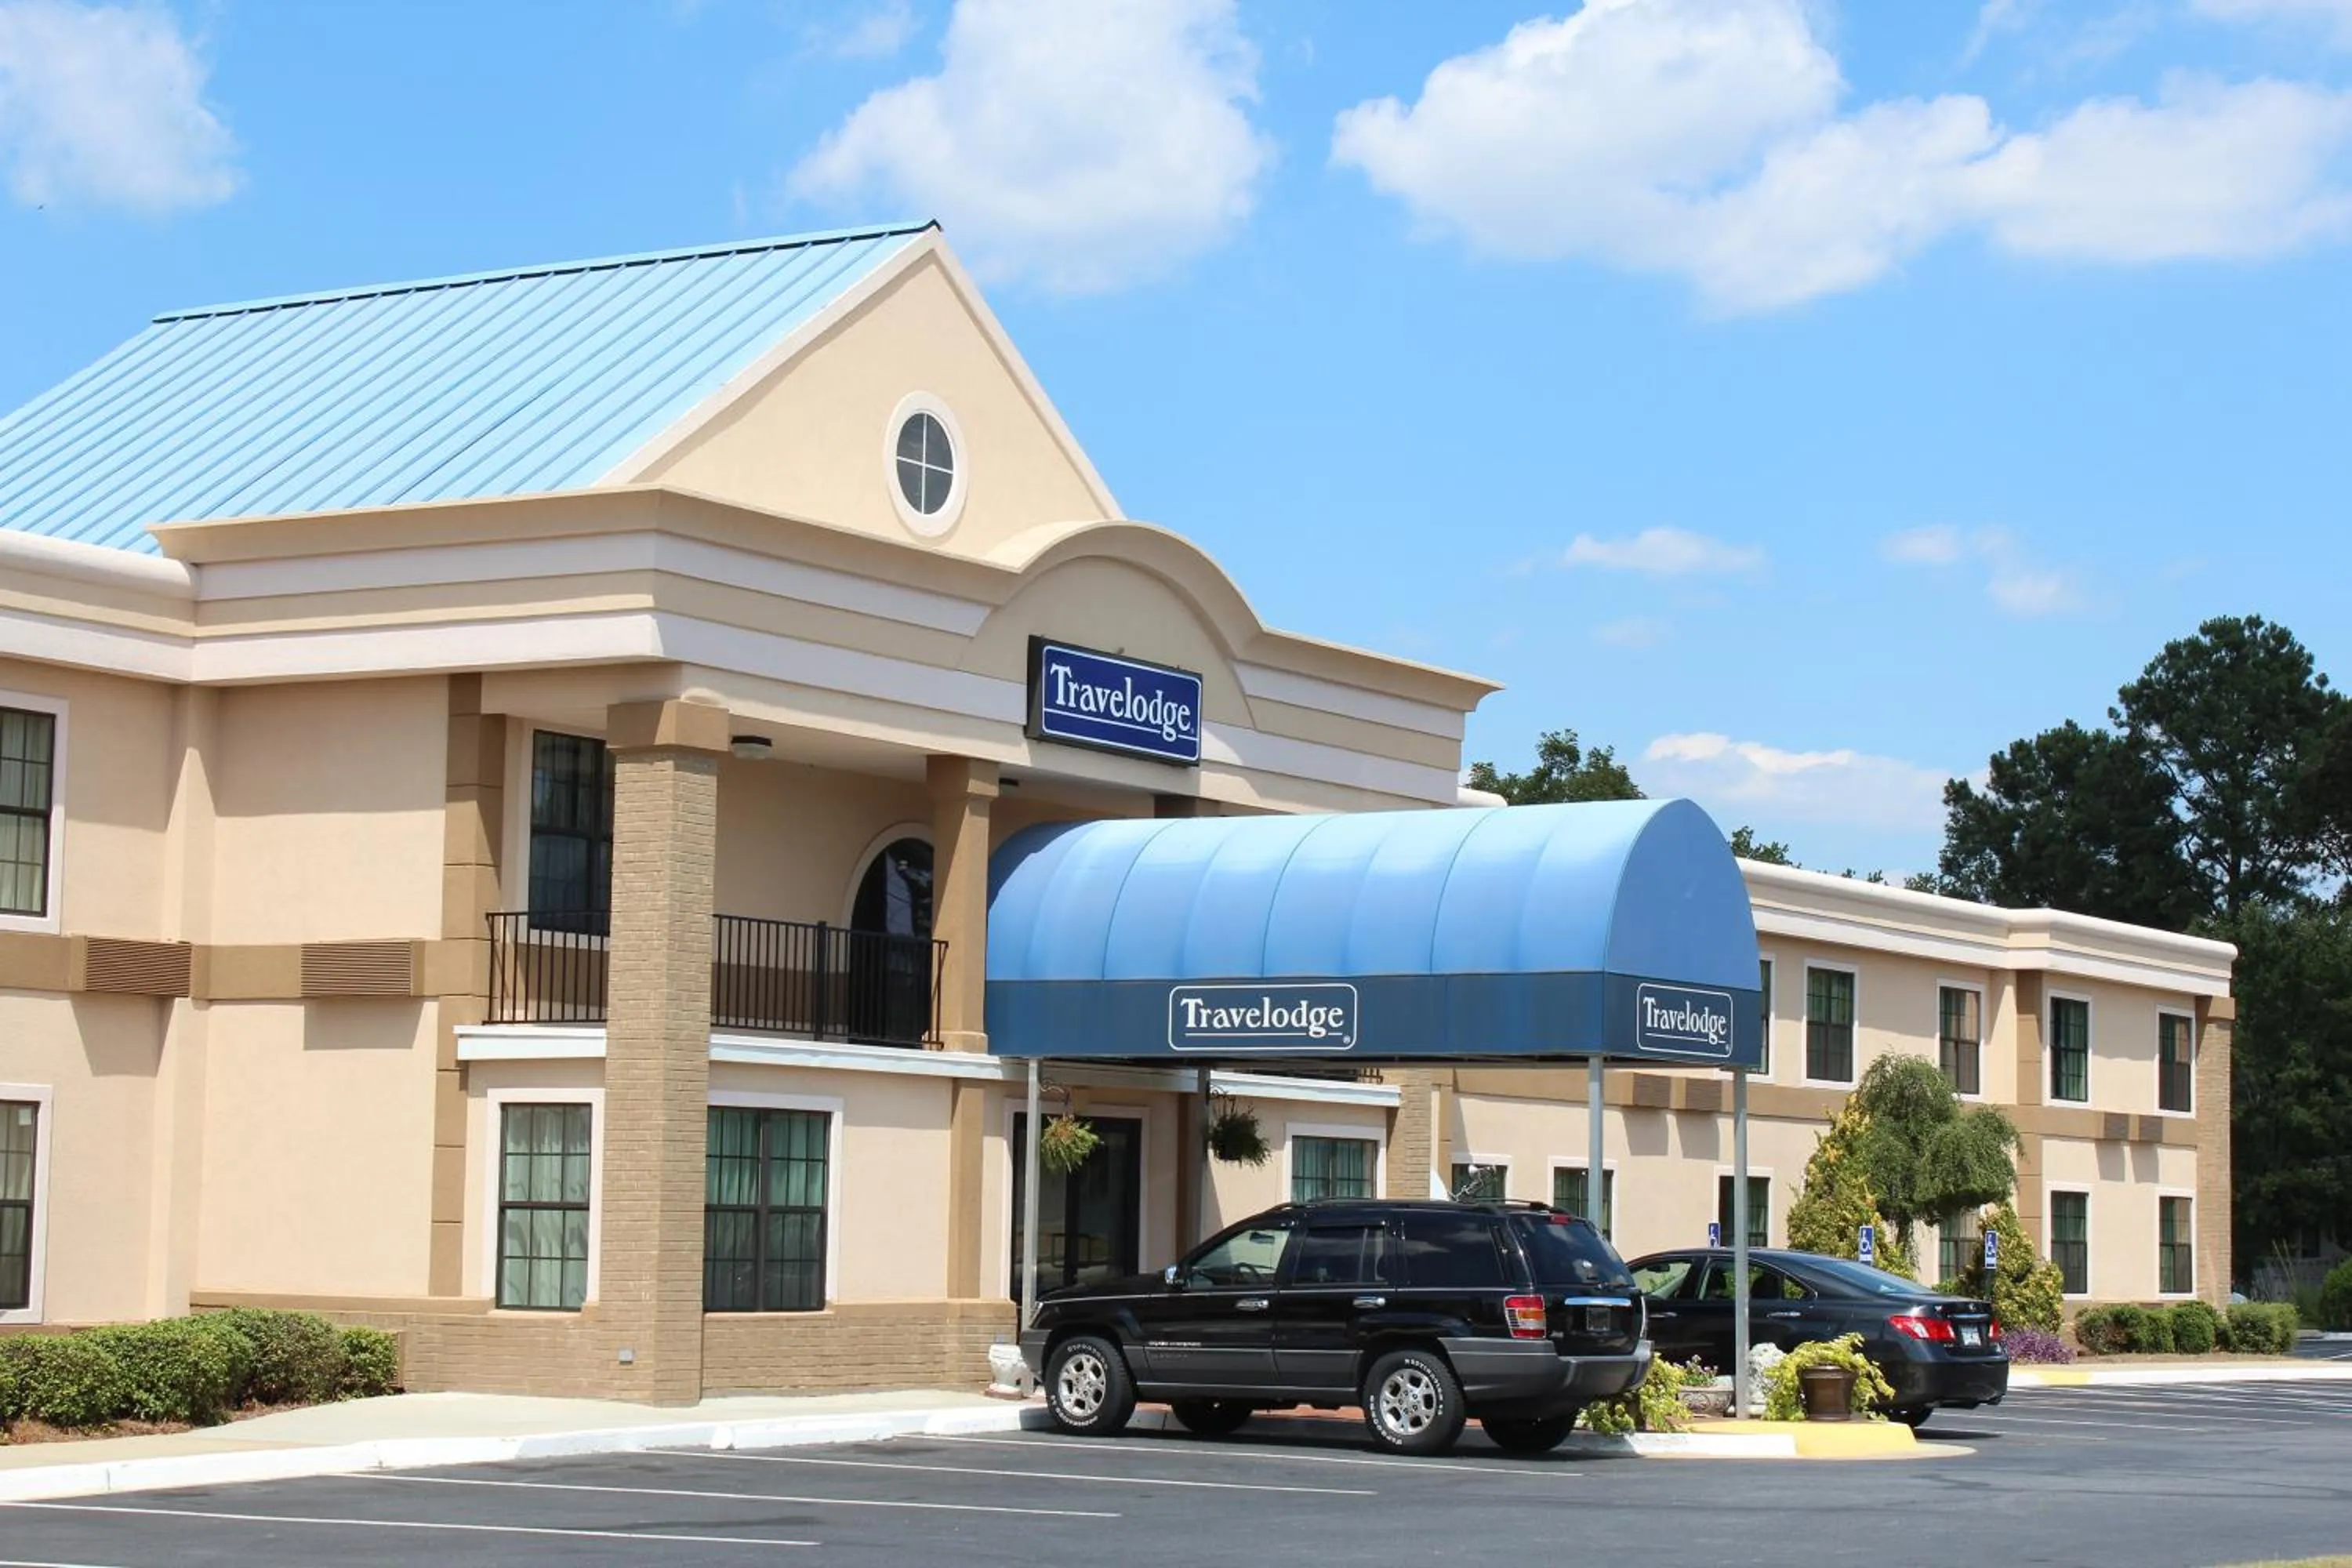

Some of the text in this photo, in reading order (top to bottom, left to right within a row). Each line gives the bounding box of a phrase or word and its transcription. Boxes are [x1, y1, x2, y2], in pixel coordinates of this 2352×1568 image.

[1050, 663, 1190, 742] Travelodge
[1180, 996, 1344, 1038] Travelodge
[1643, 996, 1726, 1045] Travelodge
